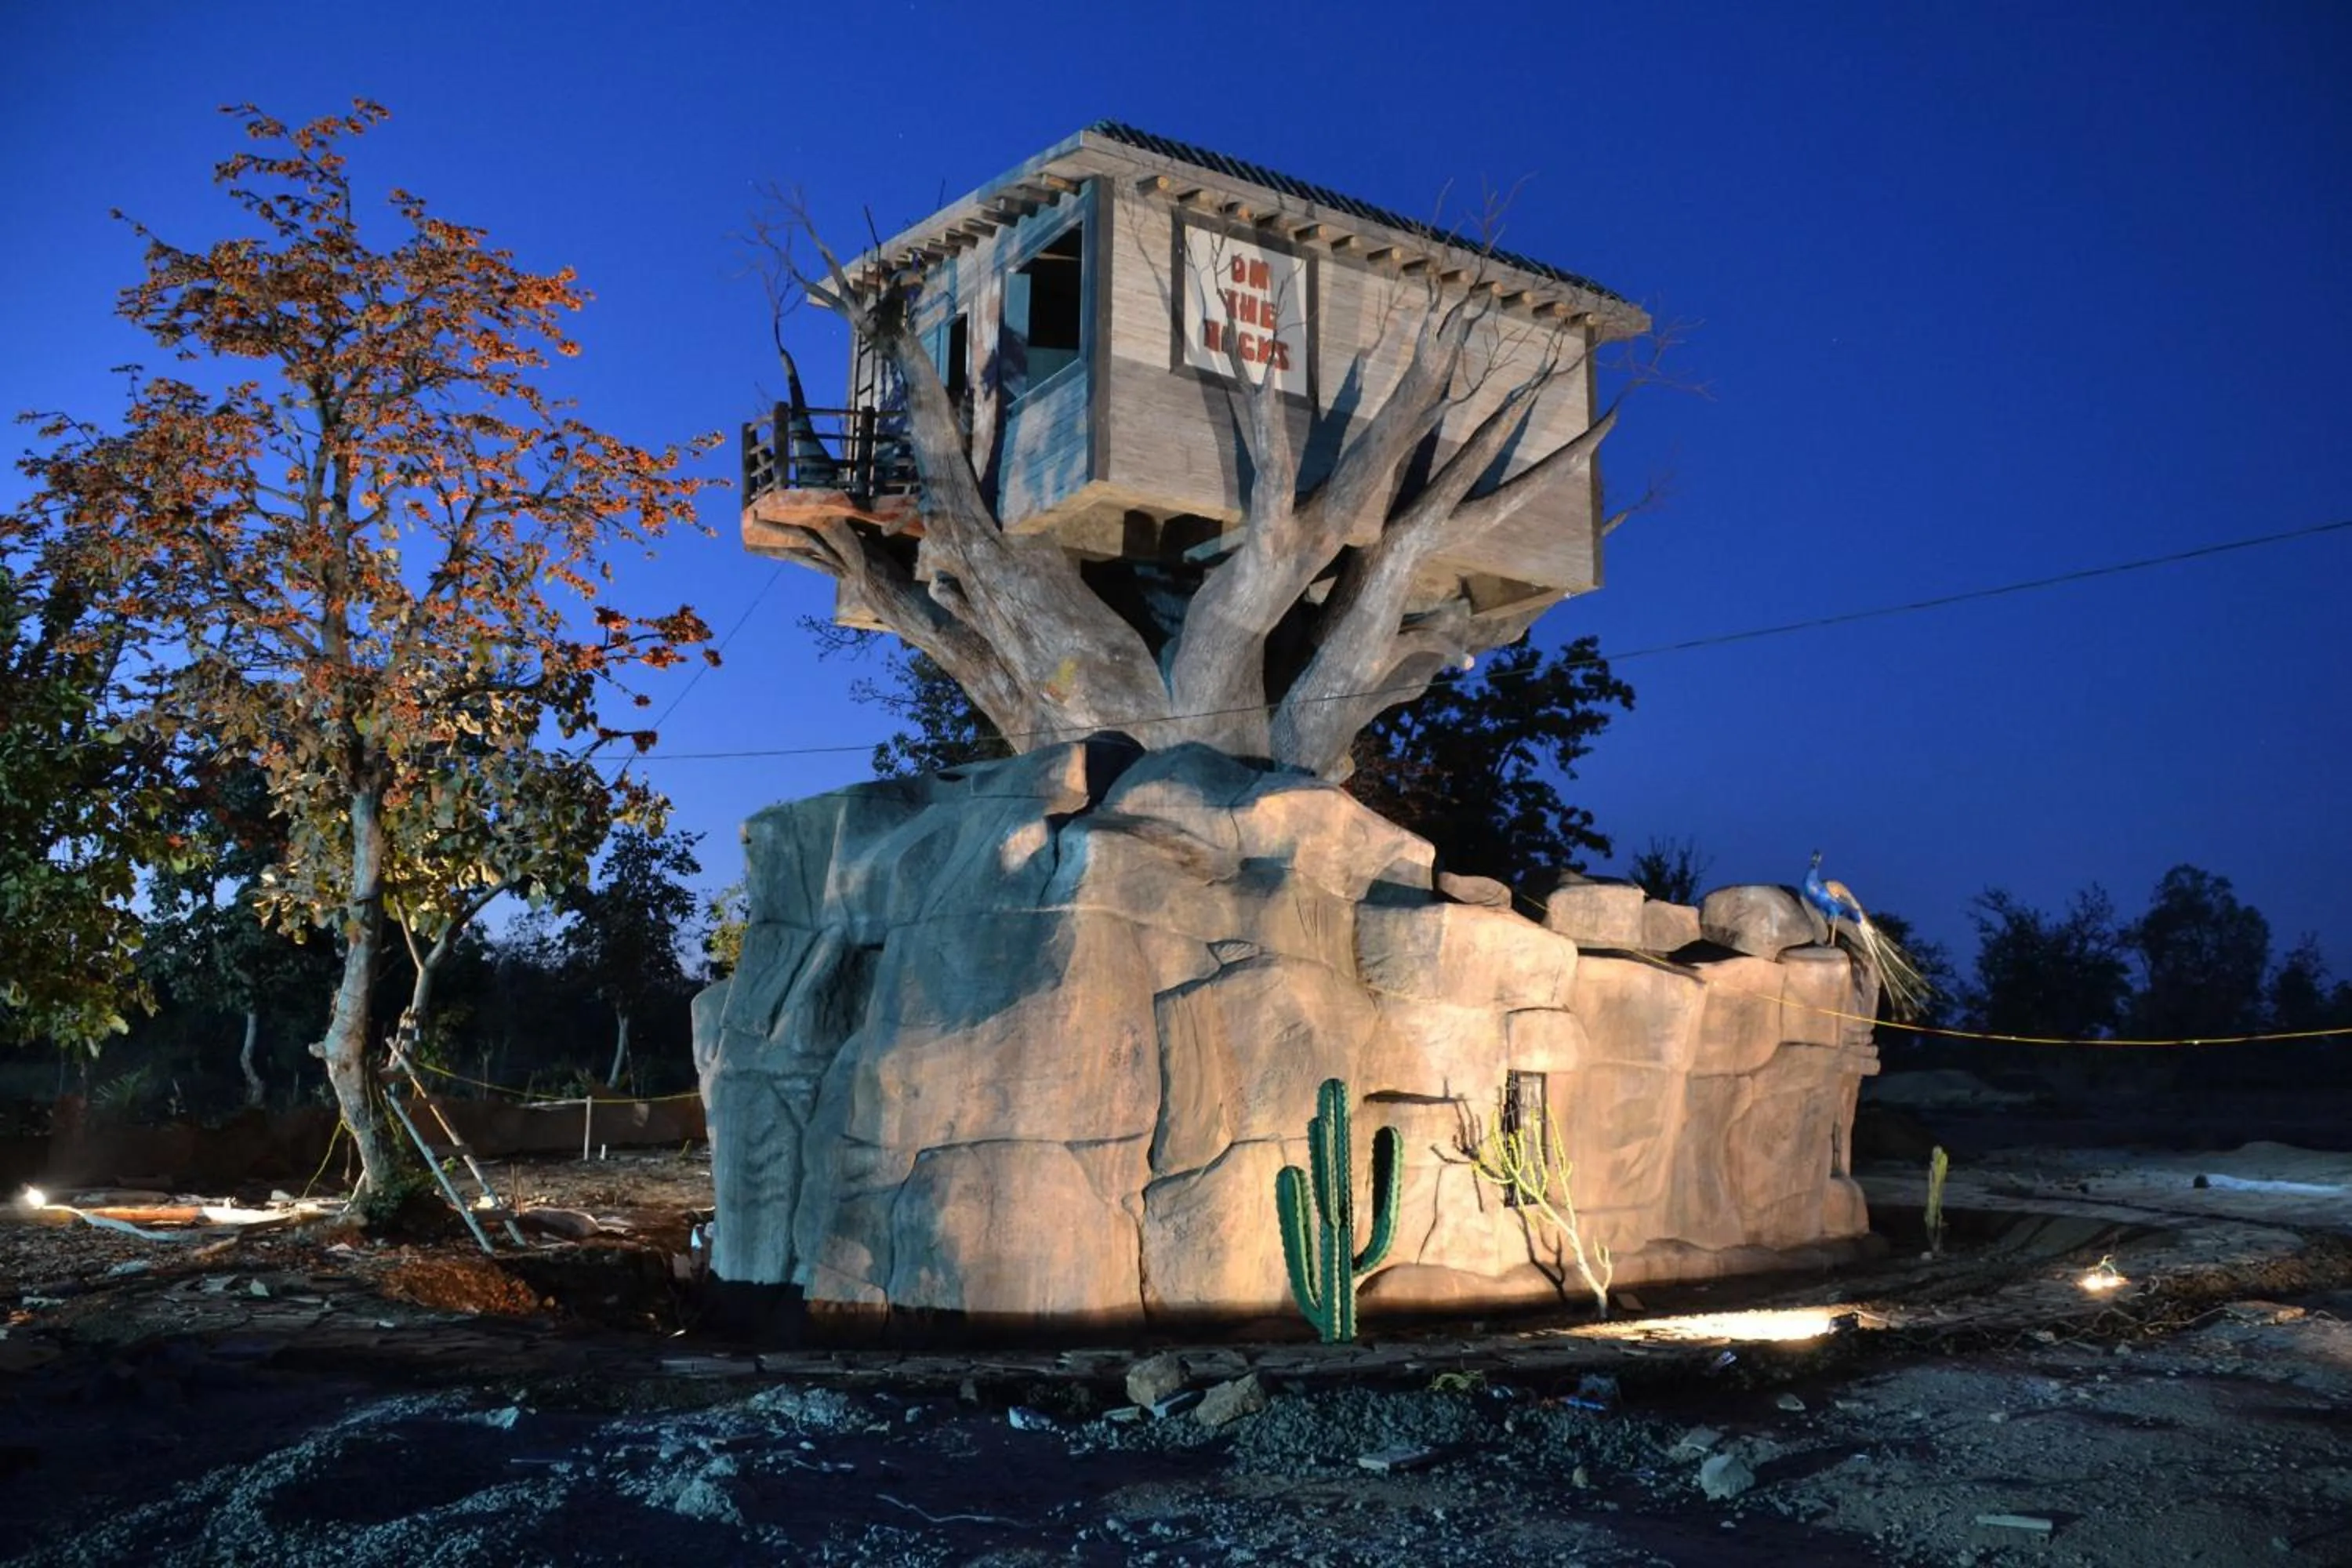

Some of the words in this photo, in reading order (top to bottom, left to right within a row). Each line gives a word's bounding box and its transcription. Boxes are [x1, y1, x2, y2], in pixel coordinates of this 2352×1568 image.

[1231, 256, 1269, 290] ON
[1225, 289, 1276, 330] THE
[1204, 320, 1290, 370] RCKS
